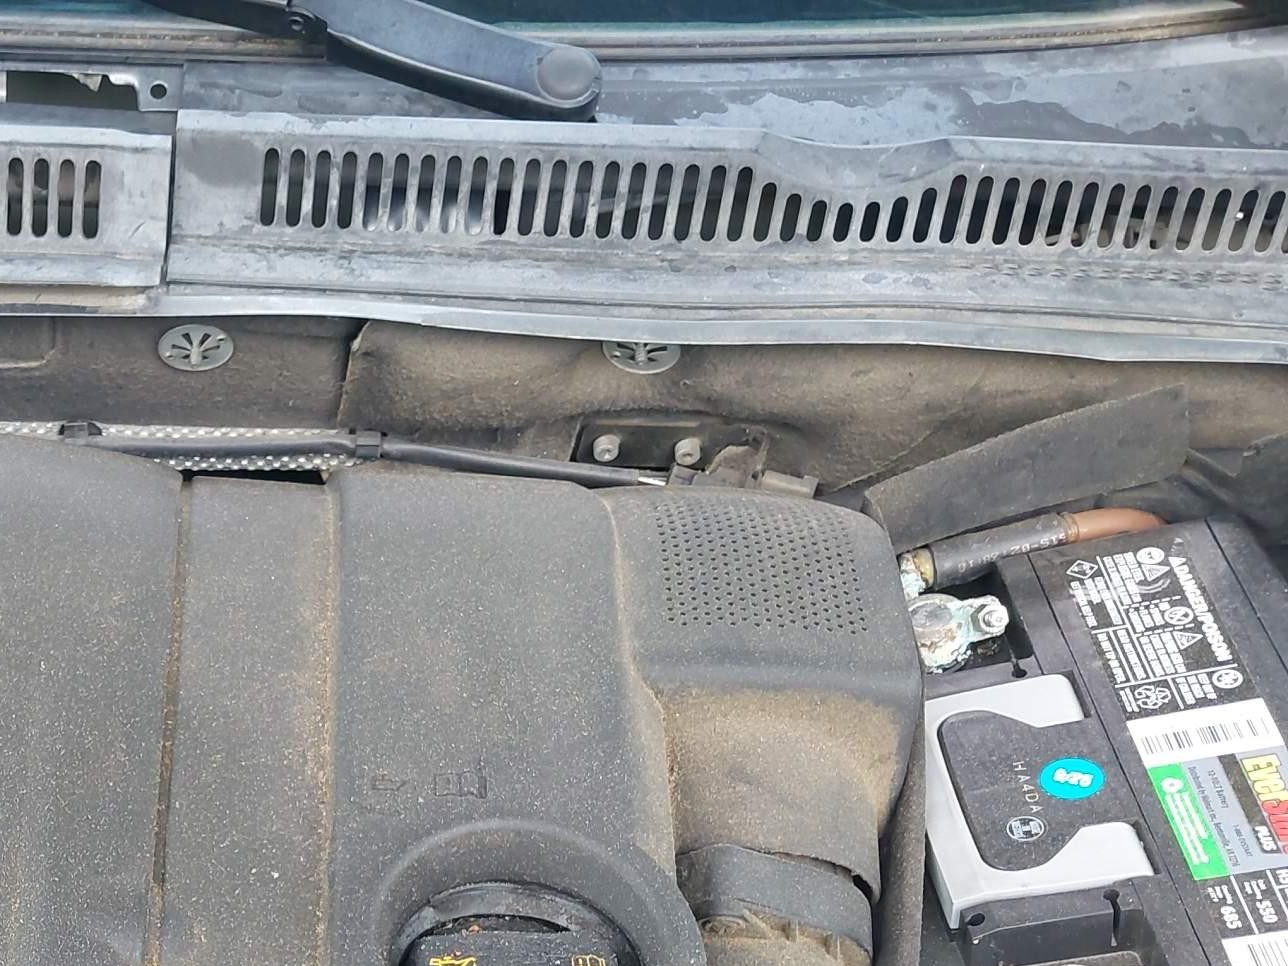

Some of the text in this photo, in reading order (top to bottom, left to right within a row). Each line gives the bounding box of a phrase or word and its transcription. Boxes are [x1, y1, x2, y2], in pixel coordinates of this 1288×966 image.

[1254, 825, 1278, 852] PLUS
[1220, 905, 1243, 930] 685
[1255, 899, 1279, 924] 550
